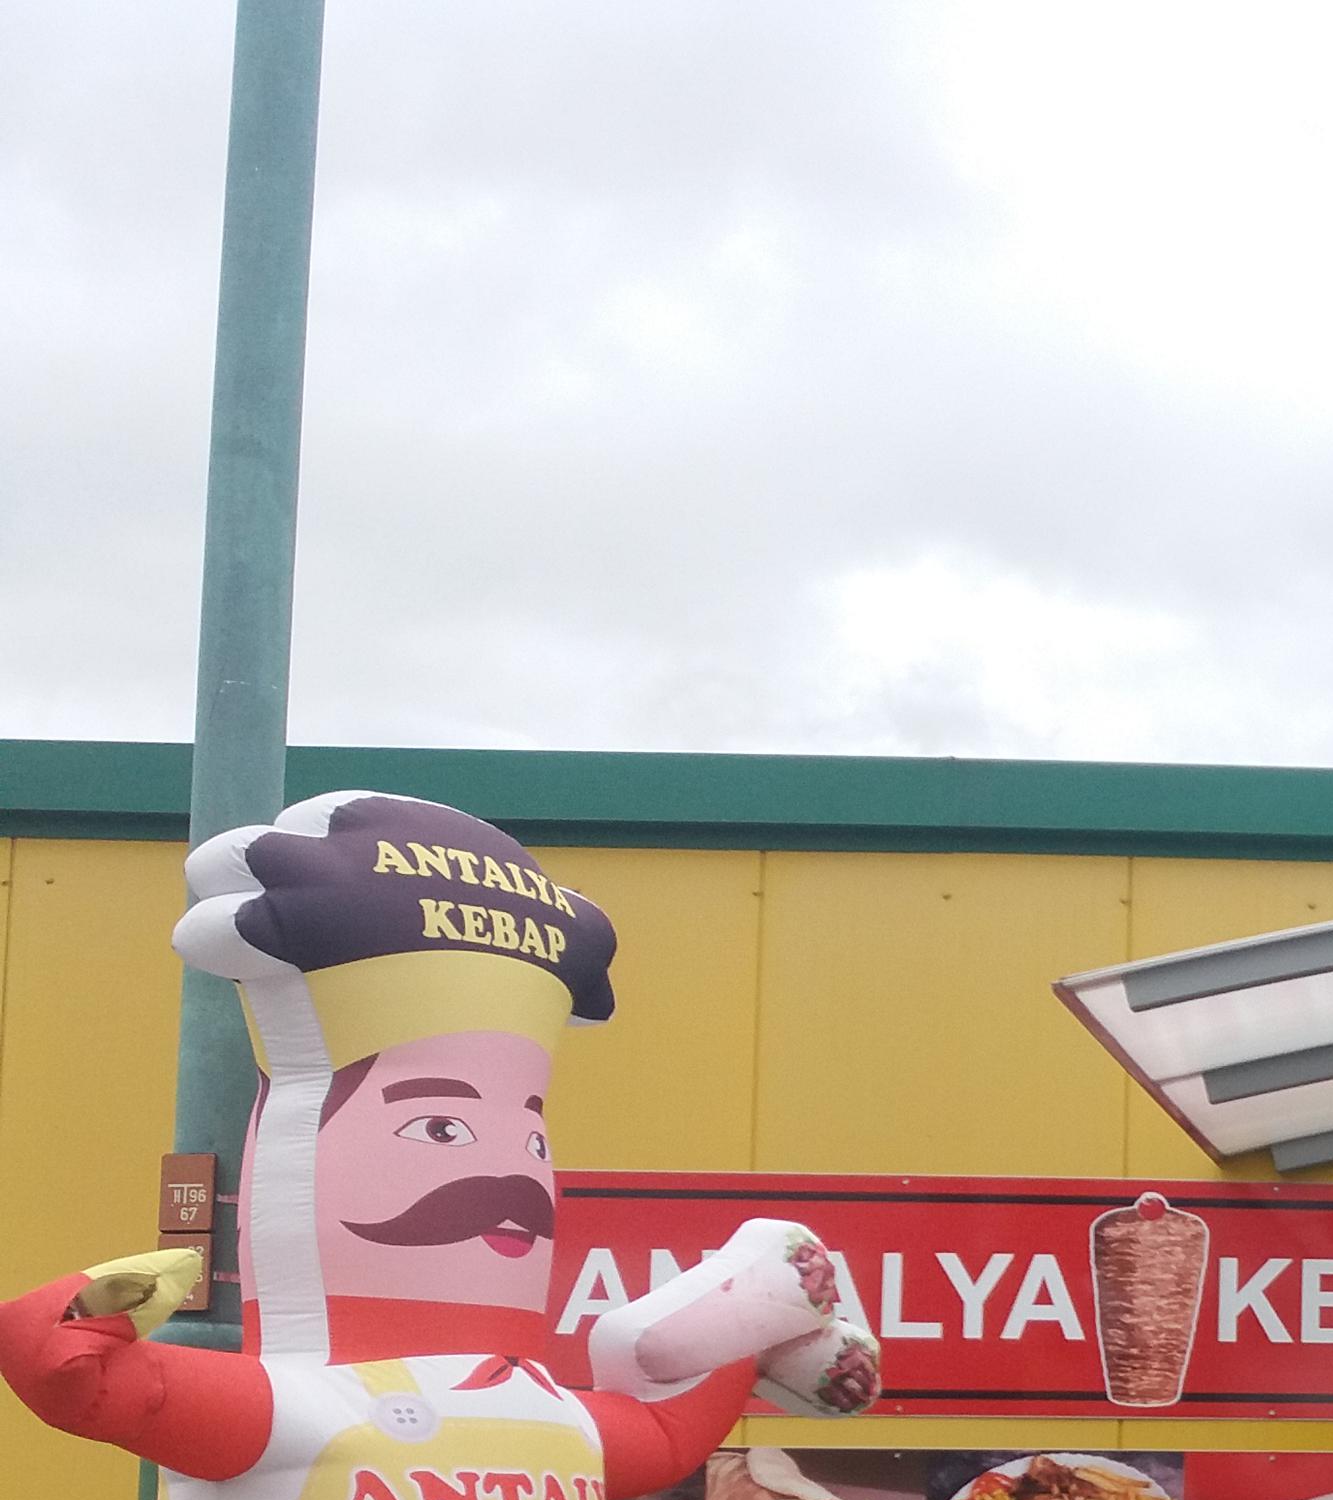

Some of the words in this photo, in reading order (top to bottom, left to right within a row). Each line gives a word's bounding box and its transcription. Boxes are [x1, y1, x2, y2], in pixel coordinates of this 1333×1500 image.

[373, 839, 577, 918] ANTALYA
[418, 898, 567, 963] KEBAP
[555, 1247, 1086, 1341] ALYA
